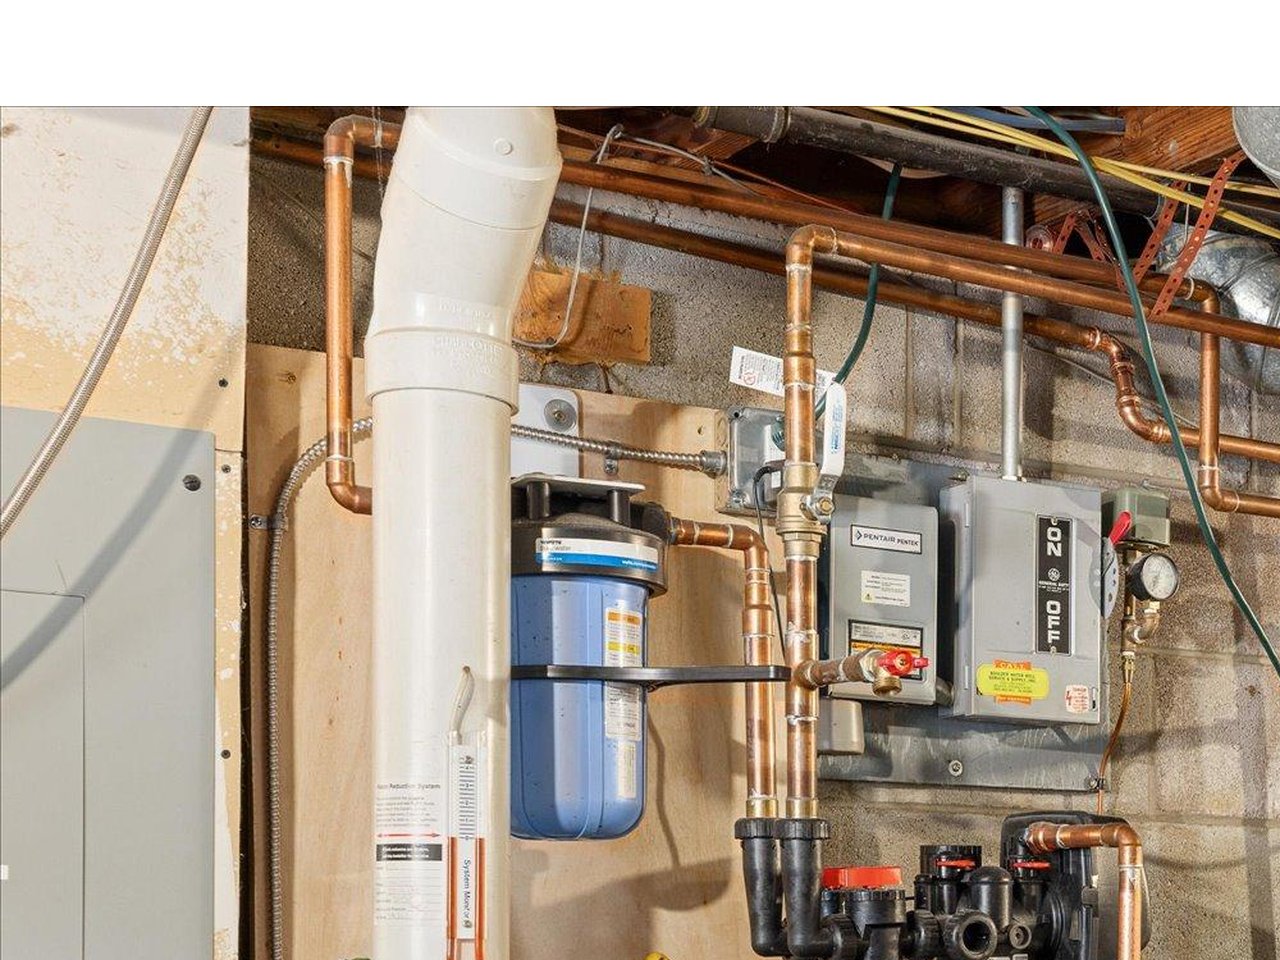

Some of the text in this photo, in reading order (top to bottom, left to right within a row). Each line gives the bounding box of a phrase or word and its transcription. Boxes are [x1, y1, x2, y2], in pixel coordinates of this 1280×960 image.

[864, 533, 895, 542] PENTAIR
[1047, 527, 1062, 557] ON
[1046, 600, 1061, 644] OFF
[463, 859, 471, 889] System
